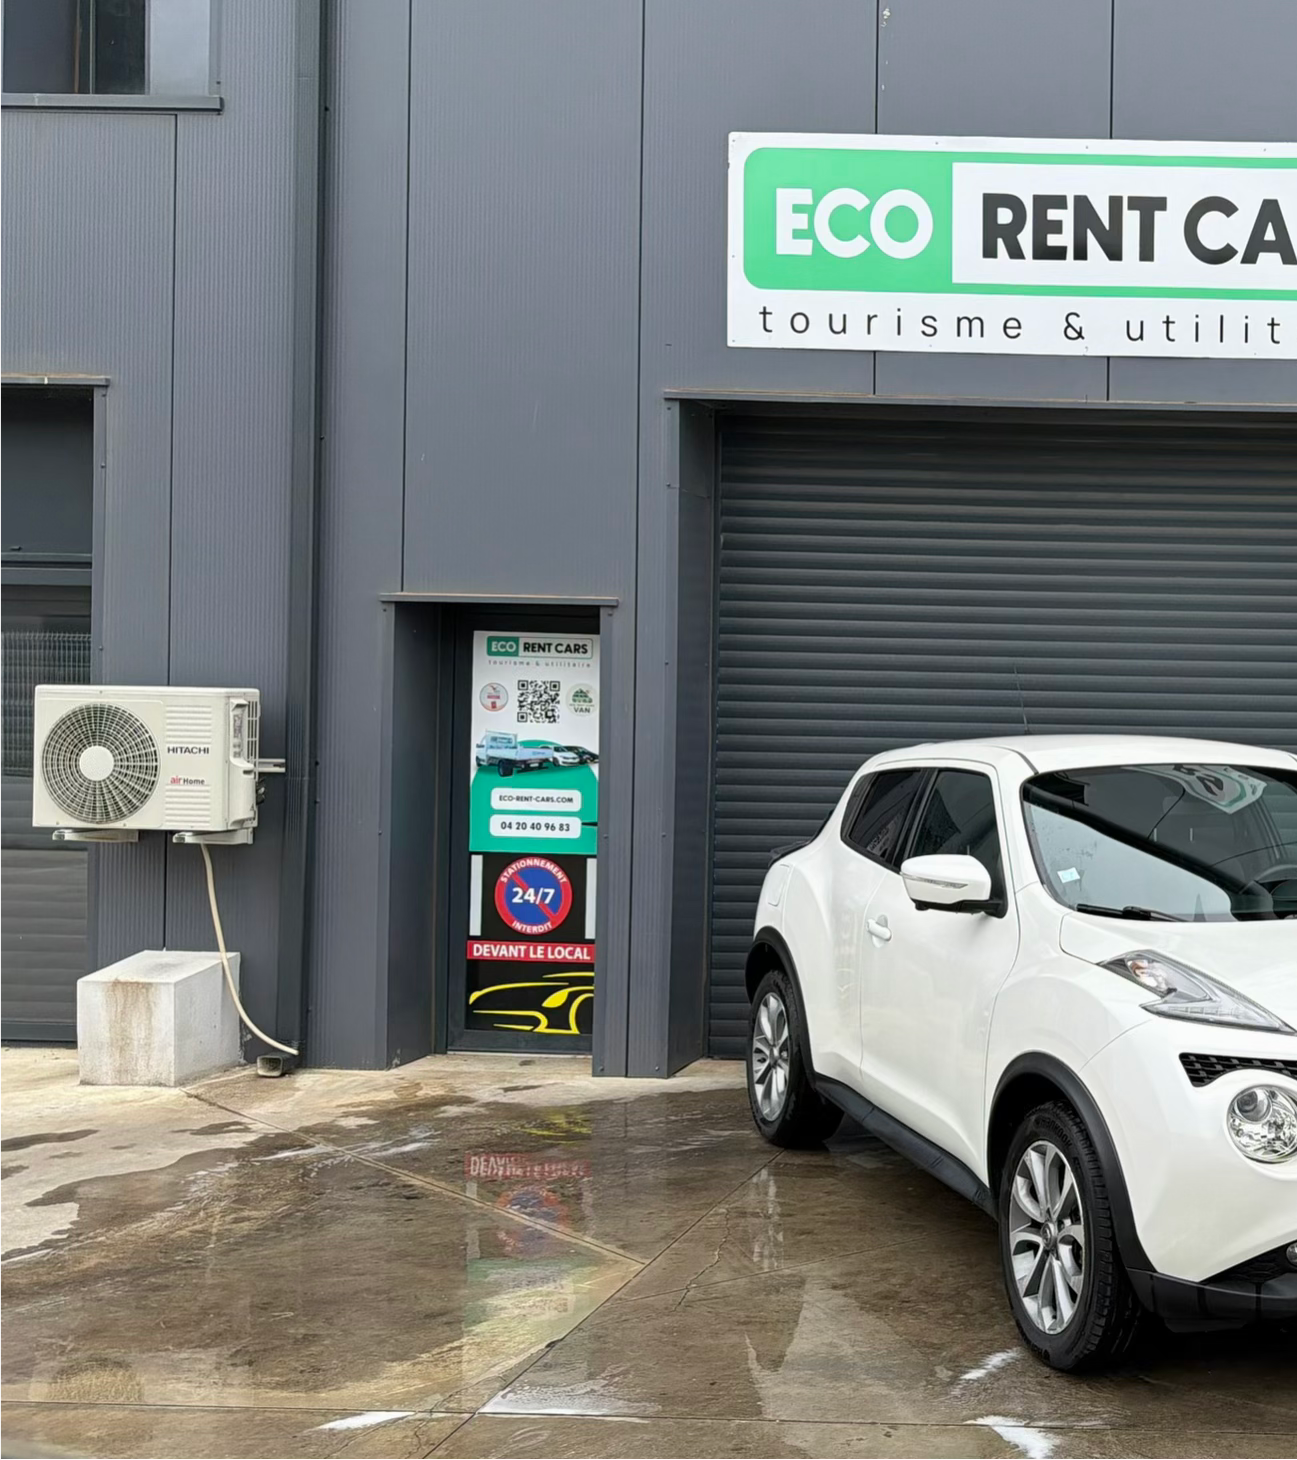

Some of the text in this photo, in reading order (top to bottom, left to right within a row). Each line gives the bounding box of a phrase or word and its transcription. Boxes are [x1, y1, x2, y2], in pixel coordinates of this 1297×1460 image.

[775, 187, 934, 260] ECO
[981, 192, 1168, 263] RENT
[758, 306, 1022, 340] tourisme
[1063, 311, 1086, 341] &
[491, 641, 588, 655] ECO RENT CARS
[573, 706, 591, 714] VAN
[167, 746, 210, 755] HITACHI
[170, 775, 205, 786] air Home
[498, 794, 574, 804] ECO-RENT-CARS.COM
[500, 821, 570, 832] 04 20 40 96 83
[501, 858, 567, 883] STATIONNEMENT
[511, 887, 555, 905] 24/7
[511, 920, 552, 934] INTERDIT
[473, 943, 591, 960] DEVANT LE LOCAL
